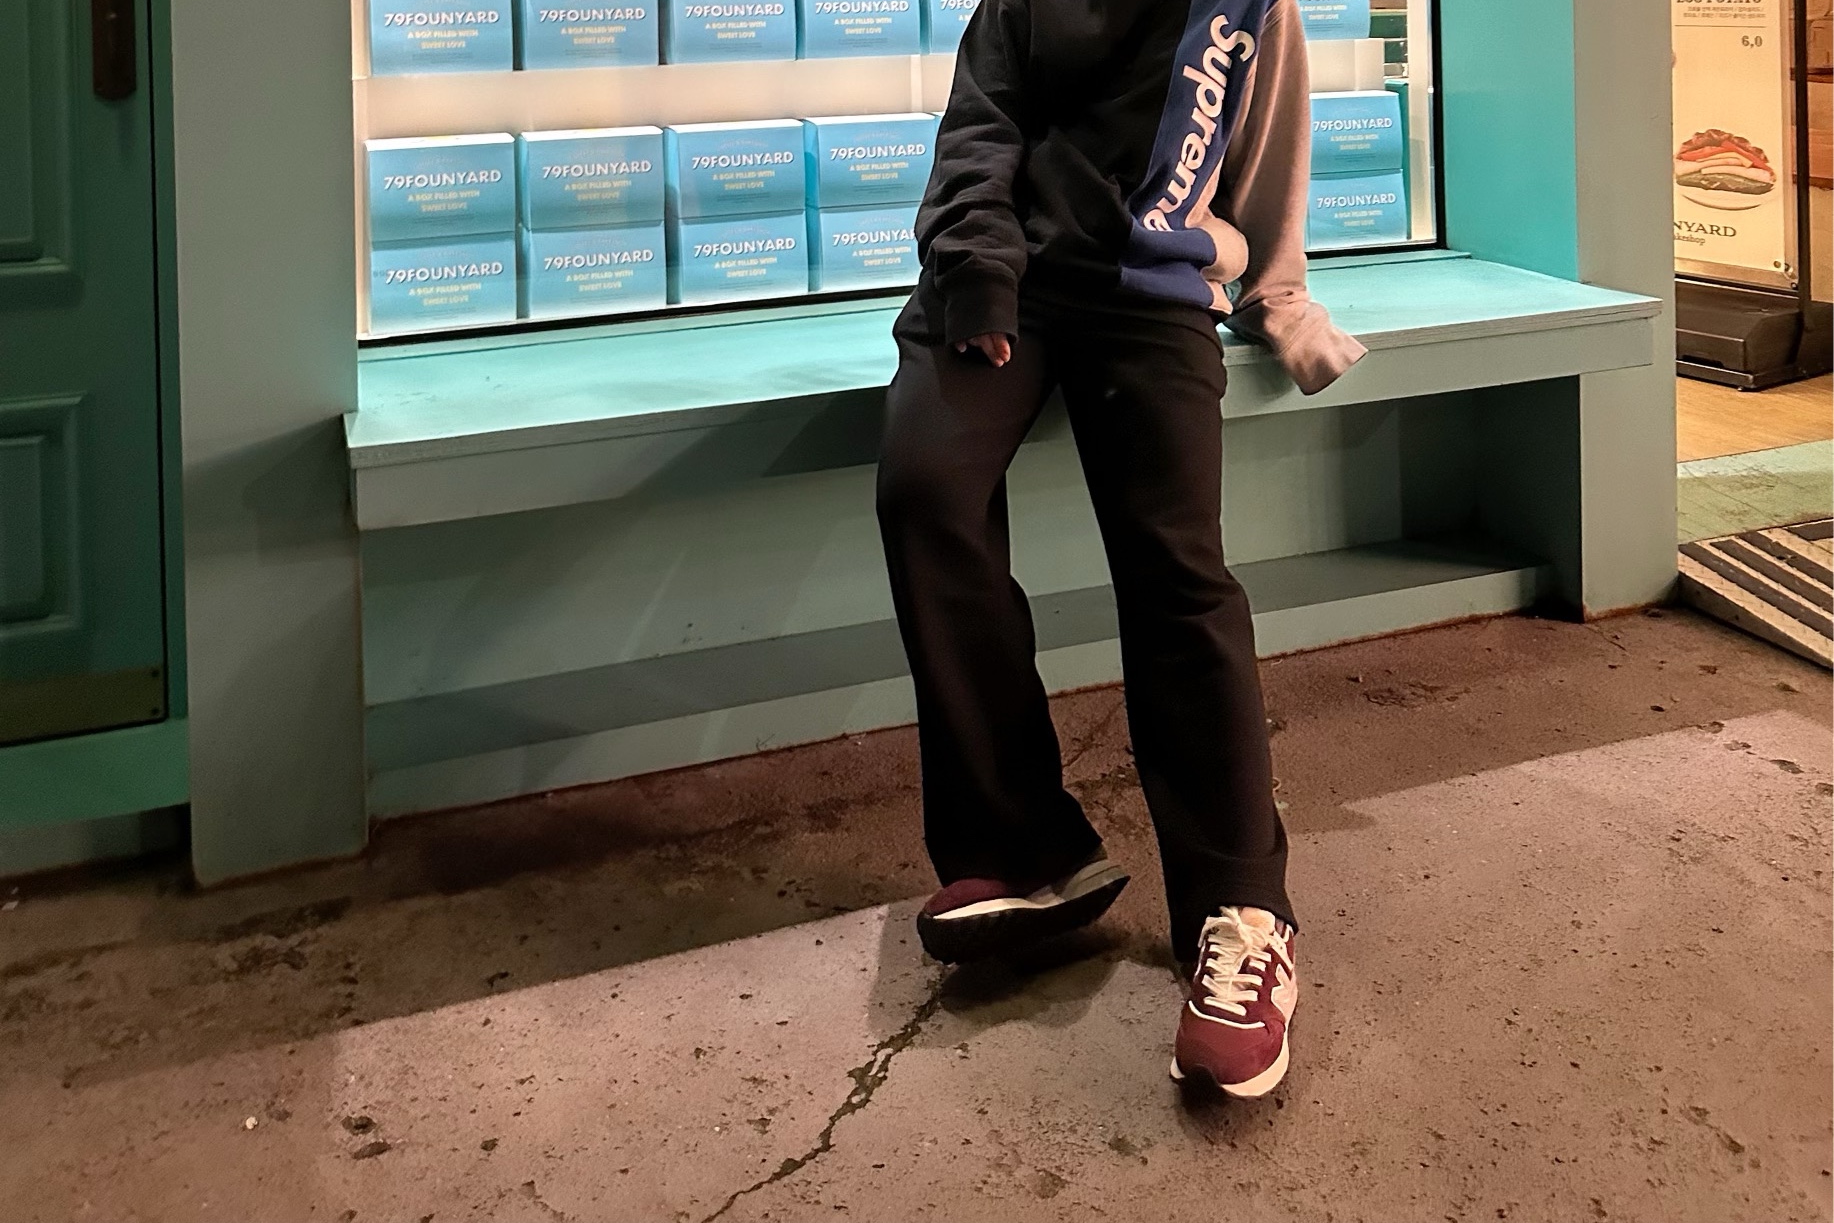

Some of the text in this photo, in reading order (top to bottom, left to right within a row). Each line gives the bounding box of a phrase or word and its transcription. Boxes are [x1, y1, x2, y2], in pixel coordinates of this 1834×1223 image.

[539, 8, 645, 23] 79FOUNYARD
[686, 4, 783, 18] 79FOUNYARD
[815, 0, 908, 14] 79FOUNYARD
[384, 11, 499, 26] 79FOUNYARD
[1143, 14, 1256, 232] Supreme
[1313, 118, 1393, 132] 79FOUNYARD
[692, 151, 793, 169] 79FOUNYARD
[830, 144, 926, 160] 79FOUNYARD
[542, 159, 651, 179] 79FOUNYARD
[384, 170, 502, 190] 79FOUNYARD
[1317, 193, 1395, 209] 79FOUNYARD
[694, 238, 795, 257] 79FOUNYARD
[544, 249, 653, 270] 79FOUNYARD
[386, 262, 503, 284] 79FOUNYARD
